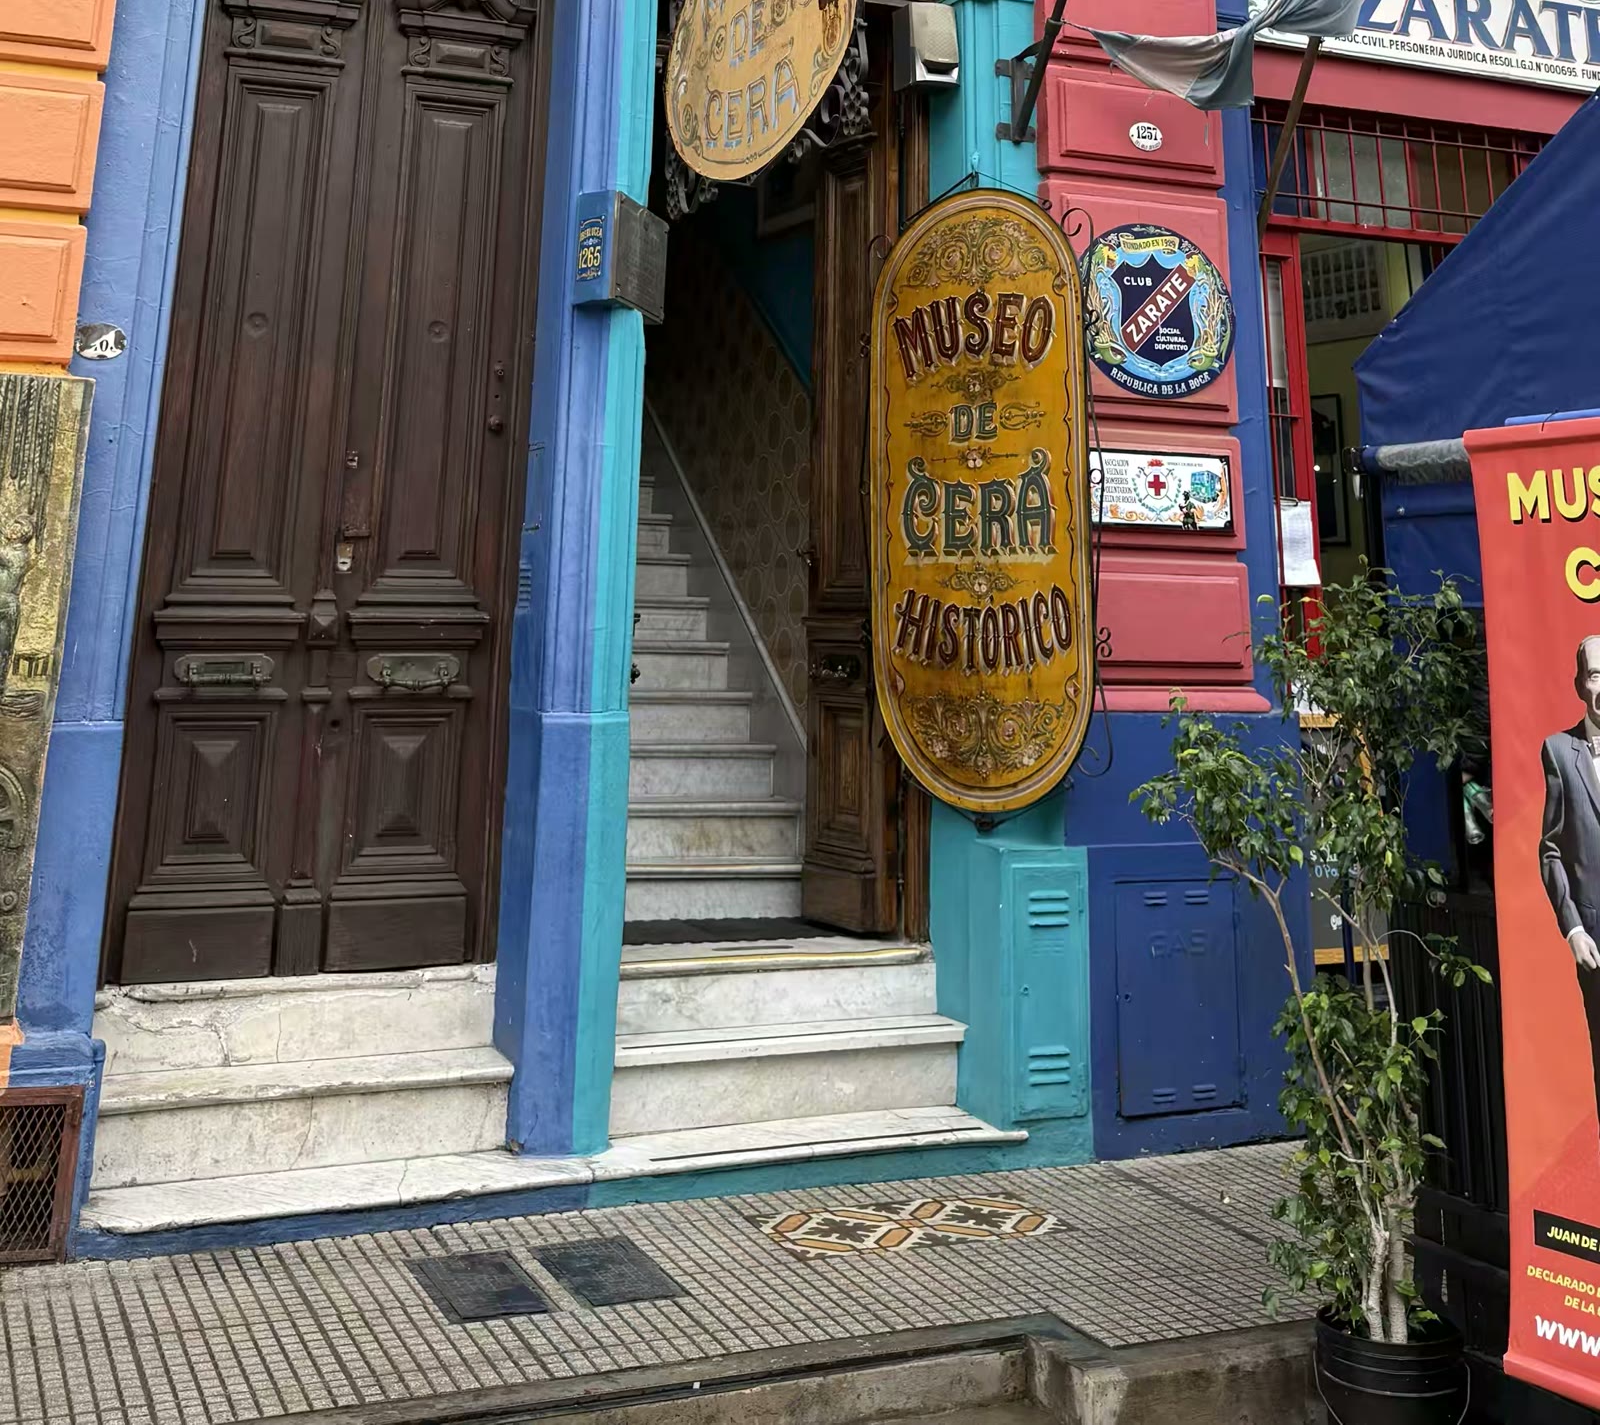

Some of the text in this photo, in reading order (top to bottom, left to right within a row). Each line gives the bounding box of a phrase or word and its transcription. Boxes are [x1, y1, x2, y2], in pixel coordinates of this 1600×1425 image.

[1447, 48, 1487, 64] JURIDICA
[704, 37, 800, 151] CERA
[1136, 125, 1158, 141] 1257
[1122, 239, 1151, 251] FUNDADO
[1151, 238, 1160, 248] EN
[578, 246, 601, 269] 1265
[1123, 276, 1153, 286] CLUB
[1126, 272, 1188, 343] ZARATE
[893, 289, 1057, 385] MUSEO
[1155, 335, 1187, 343] CULTURAL
[1159, 327, 1181, 335] SOCIAL
[1154, 343, 1189, 351] DEPORTIVO
[1110, 366, 1212, 395] REPUBLICA DE LA BOCA
[949, 400, 999, 446] DE
[901, 446, 1060, 563] CERA
[1546, 1226, 1598, 1251] JUAN DE
[1527, 1265, 1595, 1295] DECLARADO
[1564, 1295, 1595, 1315] DE LA
